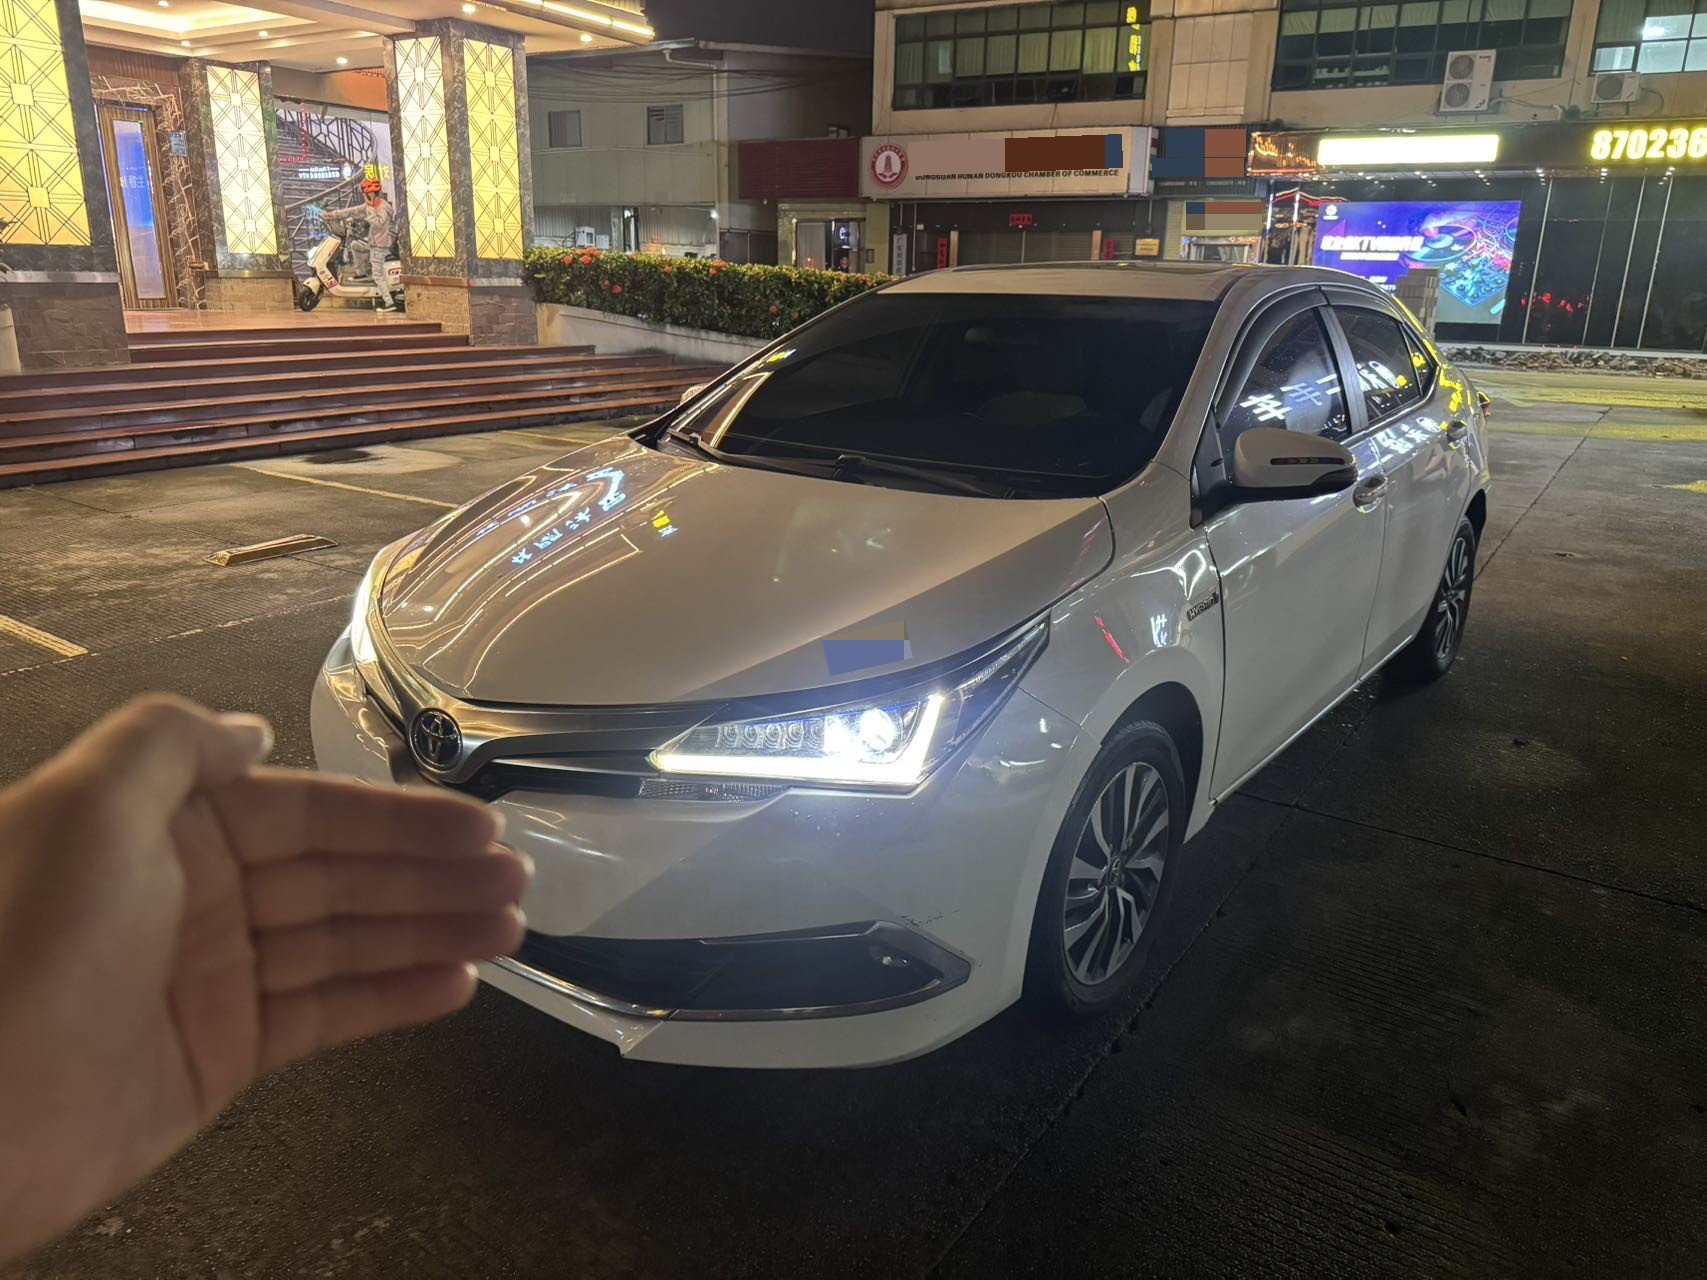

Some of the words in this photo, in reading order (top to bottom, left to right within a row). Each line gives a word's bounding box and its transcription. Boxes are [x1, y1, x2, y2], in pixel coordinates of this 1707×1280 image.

[1590, 127, 1707, 160] 870236
[1023, 170, 1061, 178] CHAMBER
[1061, 170, 1073, 178] OF
[1073, 168, 1120, 177] COMMERCE
